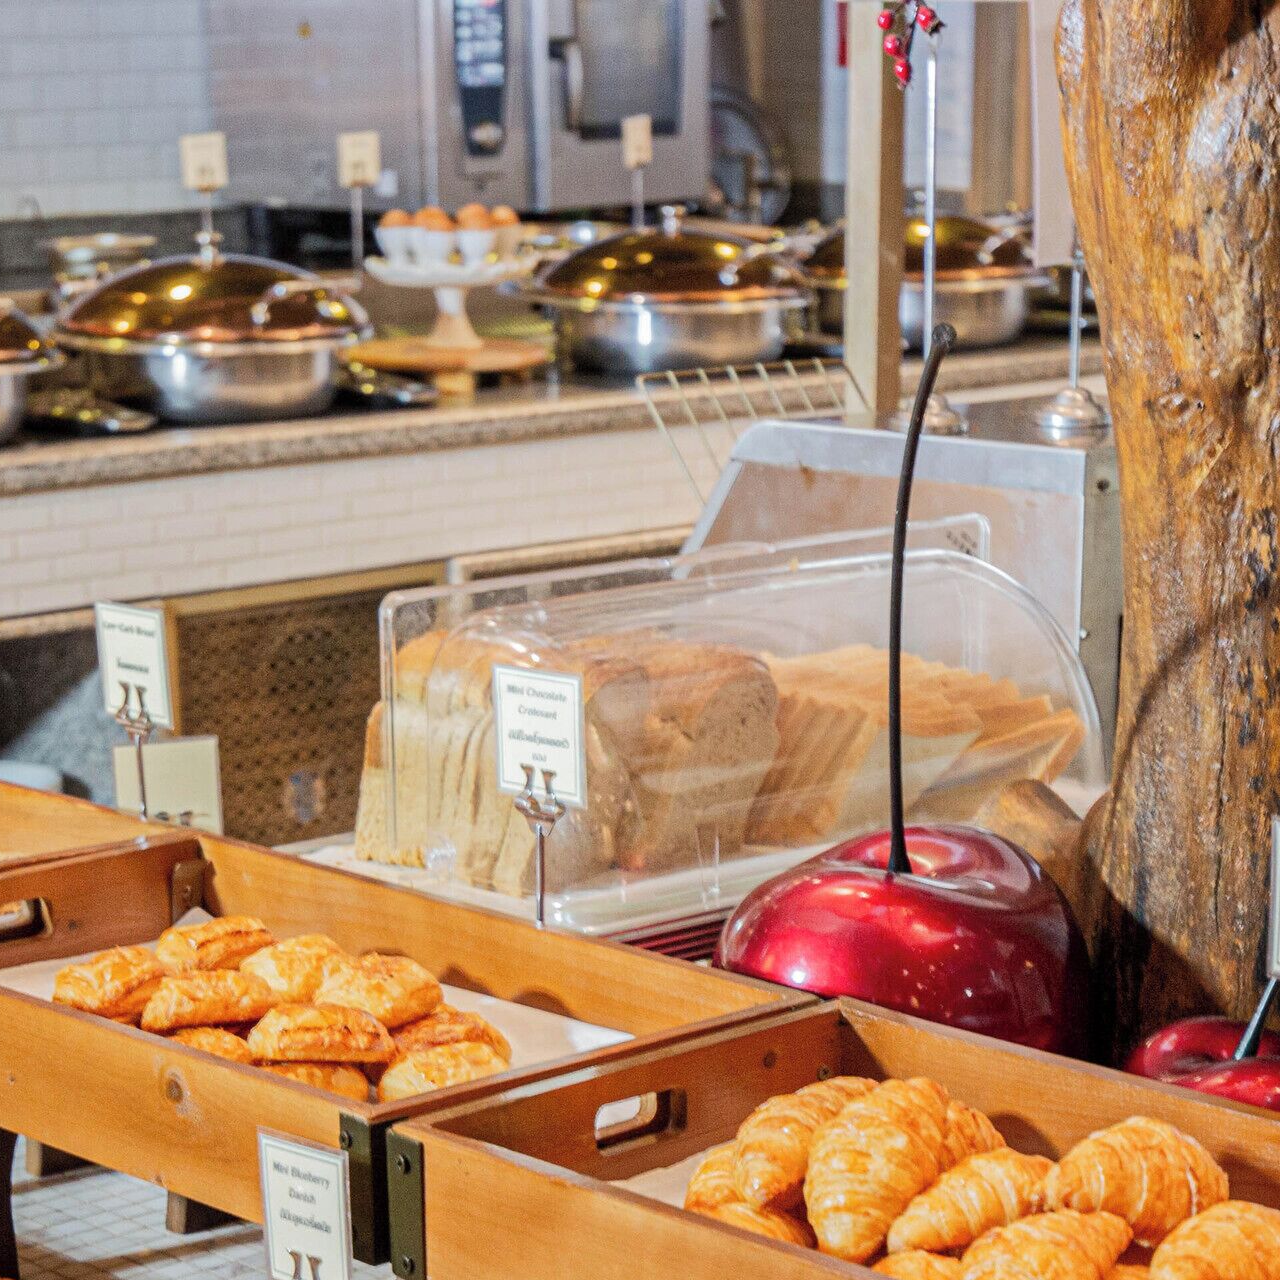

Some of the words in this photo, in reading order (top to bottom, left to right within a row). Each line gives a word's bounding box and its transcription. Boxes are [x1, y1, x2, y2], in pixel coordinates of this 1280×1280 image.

[526, 687, 568, 702] Chocolate
[272, 1161, 290, 1175] Mini
[290, 1165, 330, 1190] Blueberry
